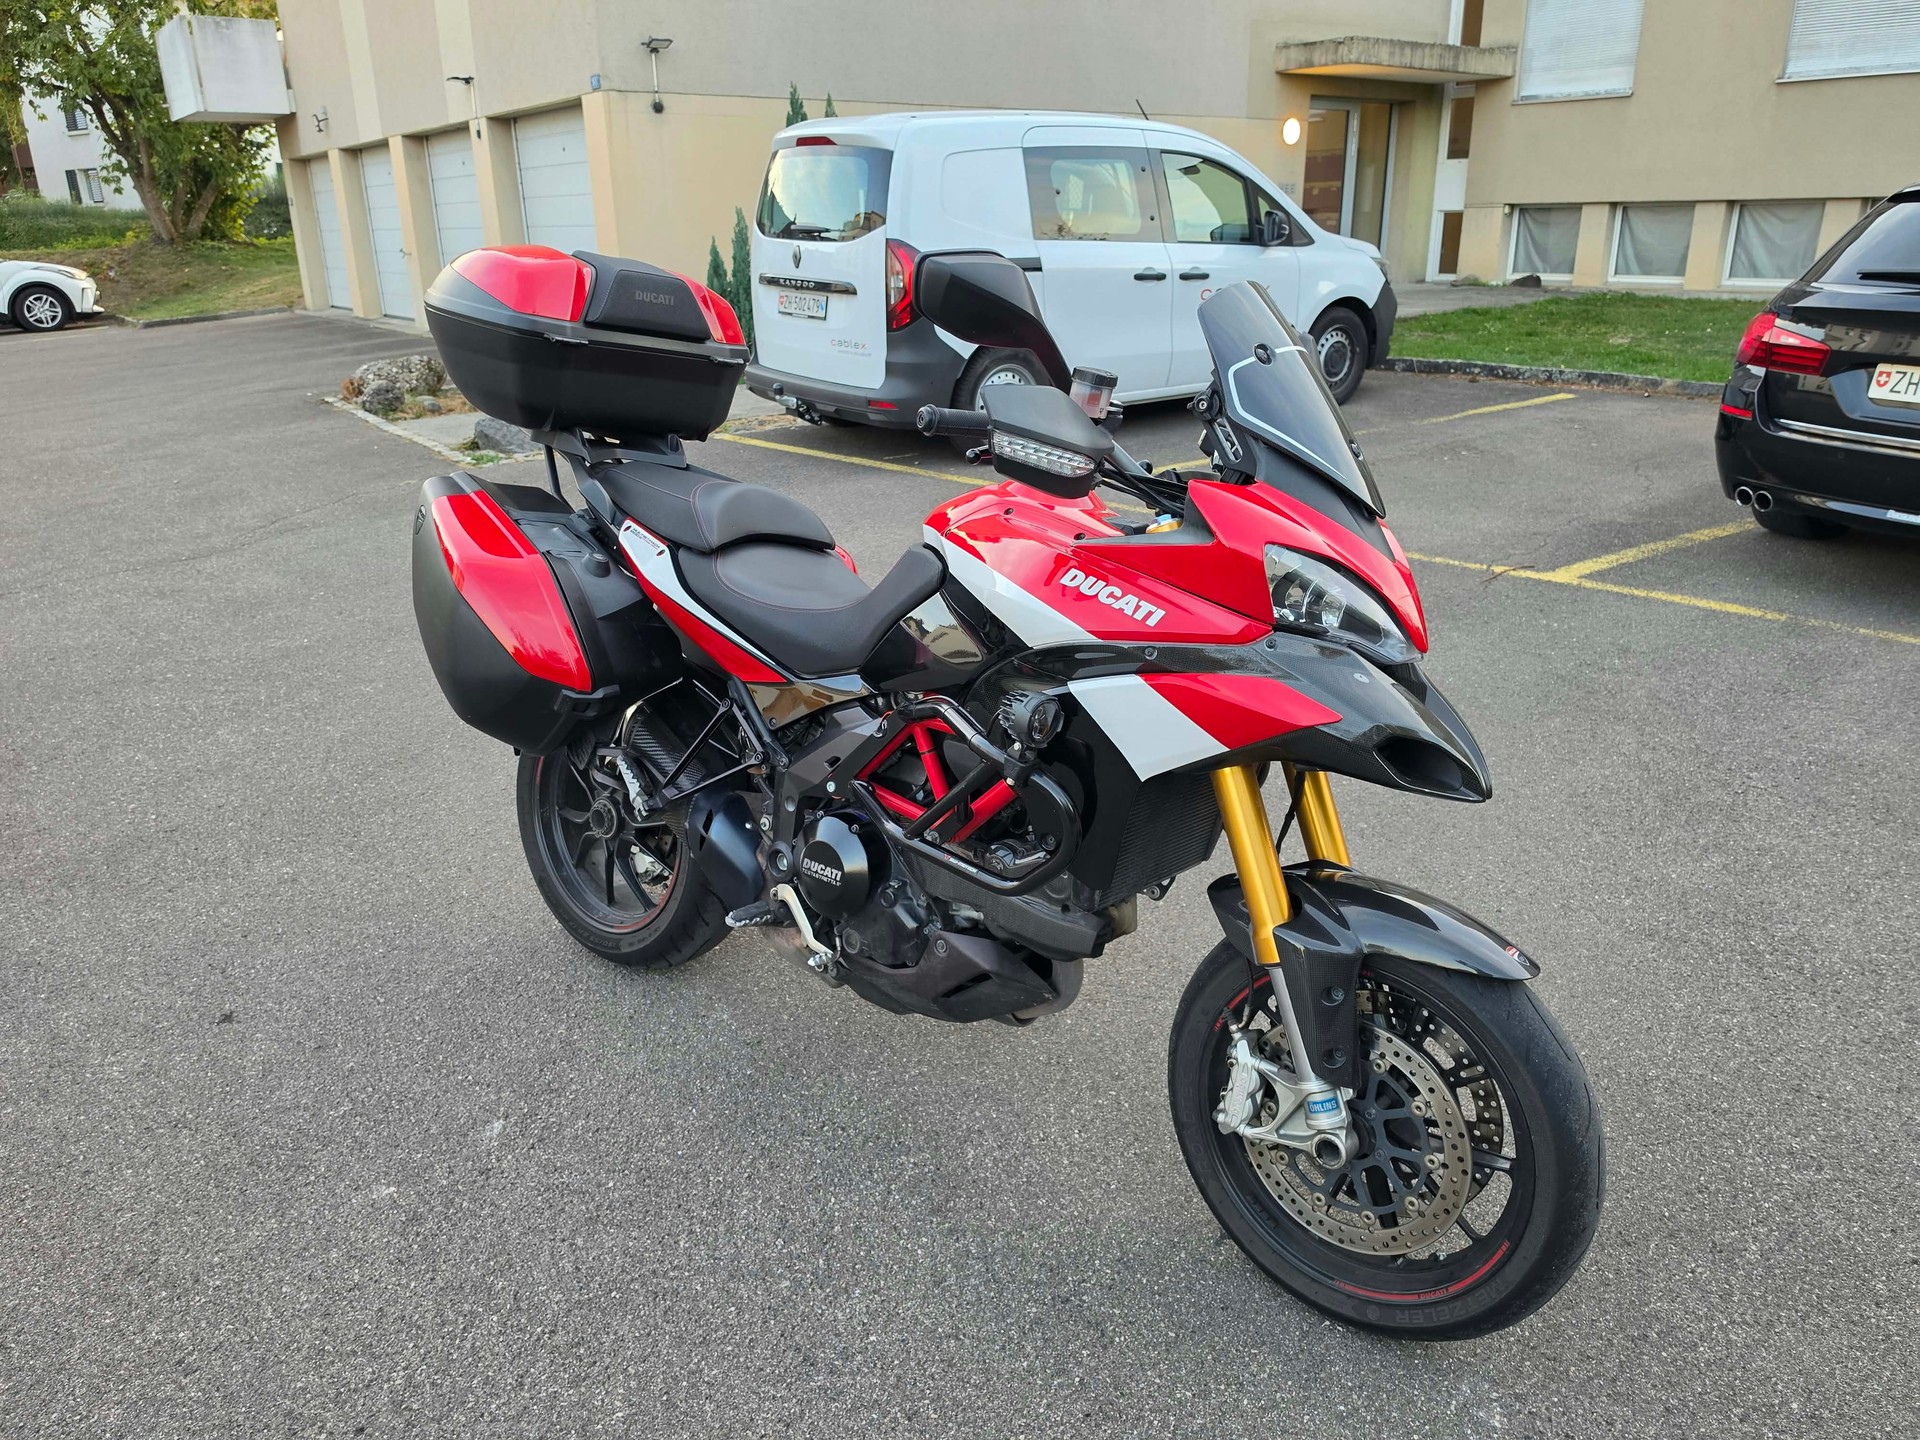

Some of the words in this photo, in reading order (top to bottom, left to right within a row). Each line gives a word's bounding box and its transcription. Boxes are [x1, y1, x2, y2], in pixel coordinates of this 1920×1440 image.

[779, 278, 815, 288] KANGOO
[635, 290, 675, 306] DUCATI
[784, 295, 793, 310] ZH
[794, 296, 820, 313] 502479
[830, 339, 868, 350] cablex
[1889, 370, 1920, 396] ZH
[1059, 567, 1167, 627] DUCATI
[802, 858, 842, 881] DUCATI
[1309, 1100, 1338, 1112] ÖHLINS
[1395, 1278, 1507, 1322] METZELER
[1419, 1288, 1448, 1300] DUCATI
